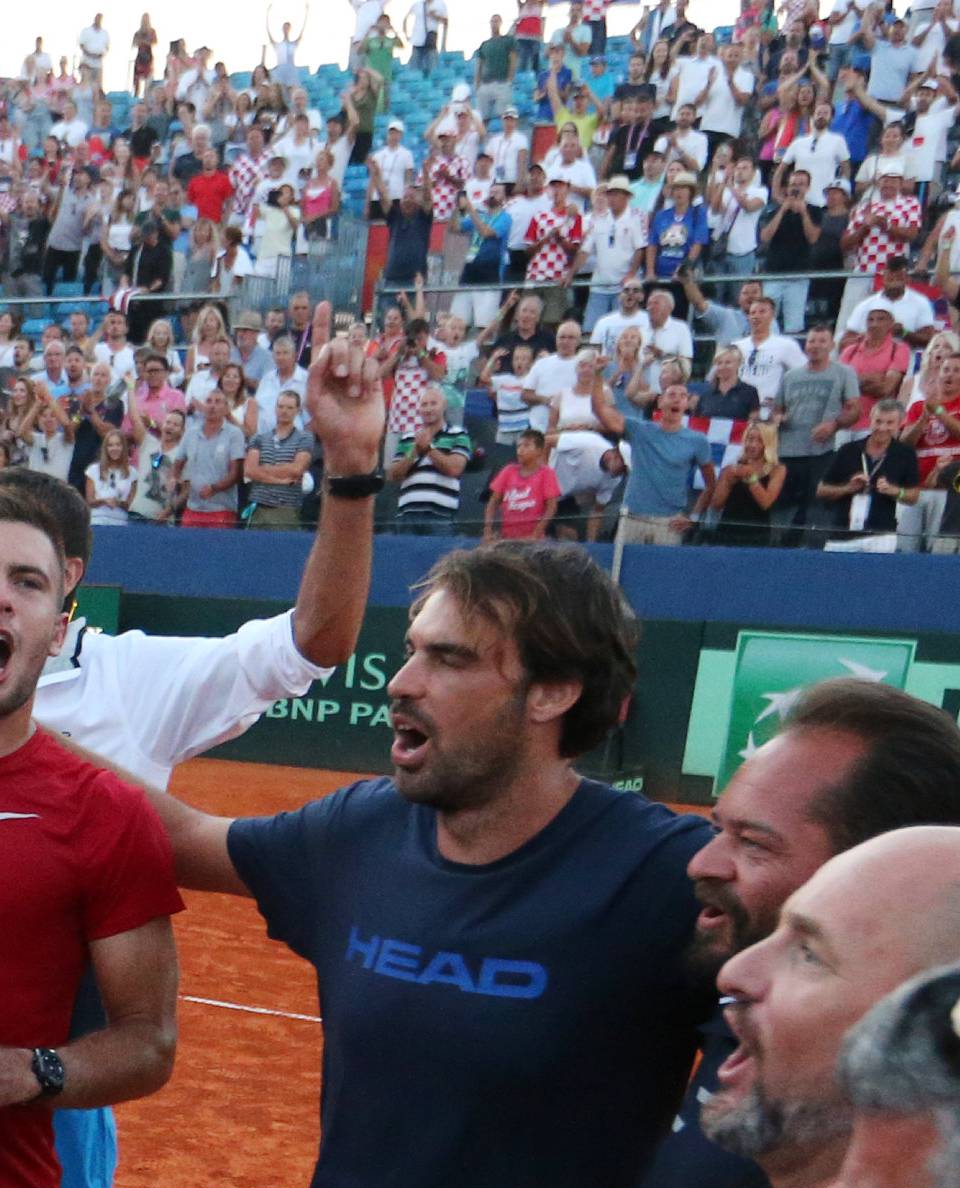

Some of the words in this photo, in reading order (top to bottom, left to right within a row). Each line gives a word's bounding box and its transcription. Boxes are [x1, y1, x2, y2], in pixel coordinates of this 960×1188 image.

[319, 653, 387, 690] IS
[266, 698, 340, 722] BNP
[344, 926, 549, 999] HEAD
